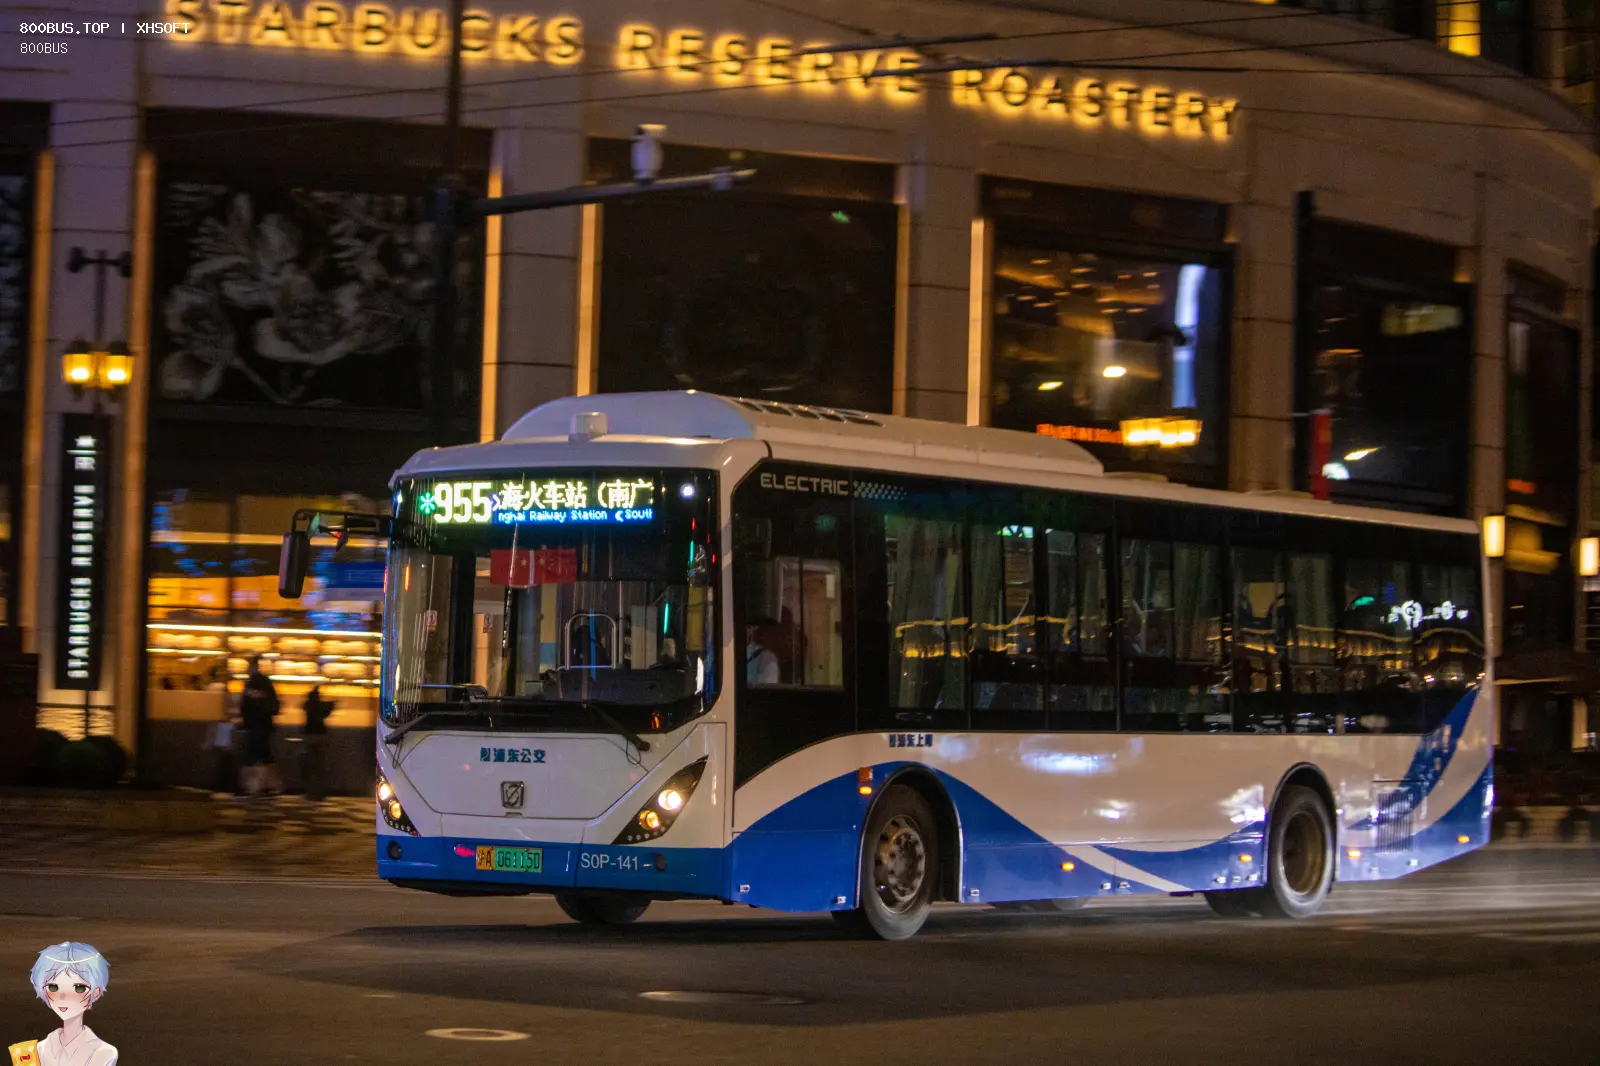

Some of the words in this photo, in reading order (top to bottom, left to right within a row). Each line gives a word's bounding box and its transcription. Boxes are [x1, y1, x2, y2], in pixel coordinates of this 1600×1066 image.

[163, 0, 584, 64] STARBUCKS
[618, 23, 924, 102] RESERVE
[950, 66, 1240, 141] ROASTERY
[760, 472, 849, 496] ELECTRIC
[434, 482, 492, 523] 955
[570, 509, 608, 521] Station
